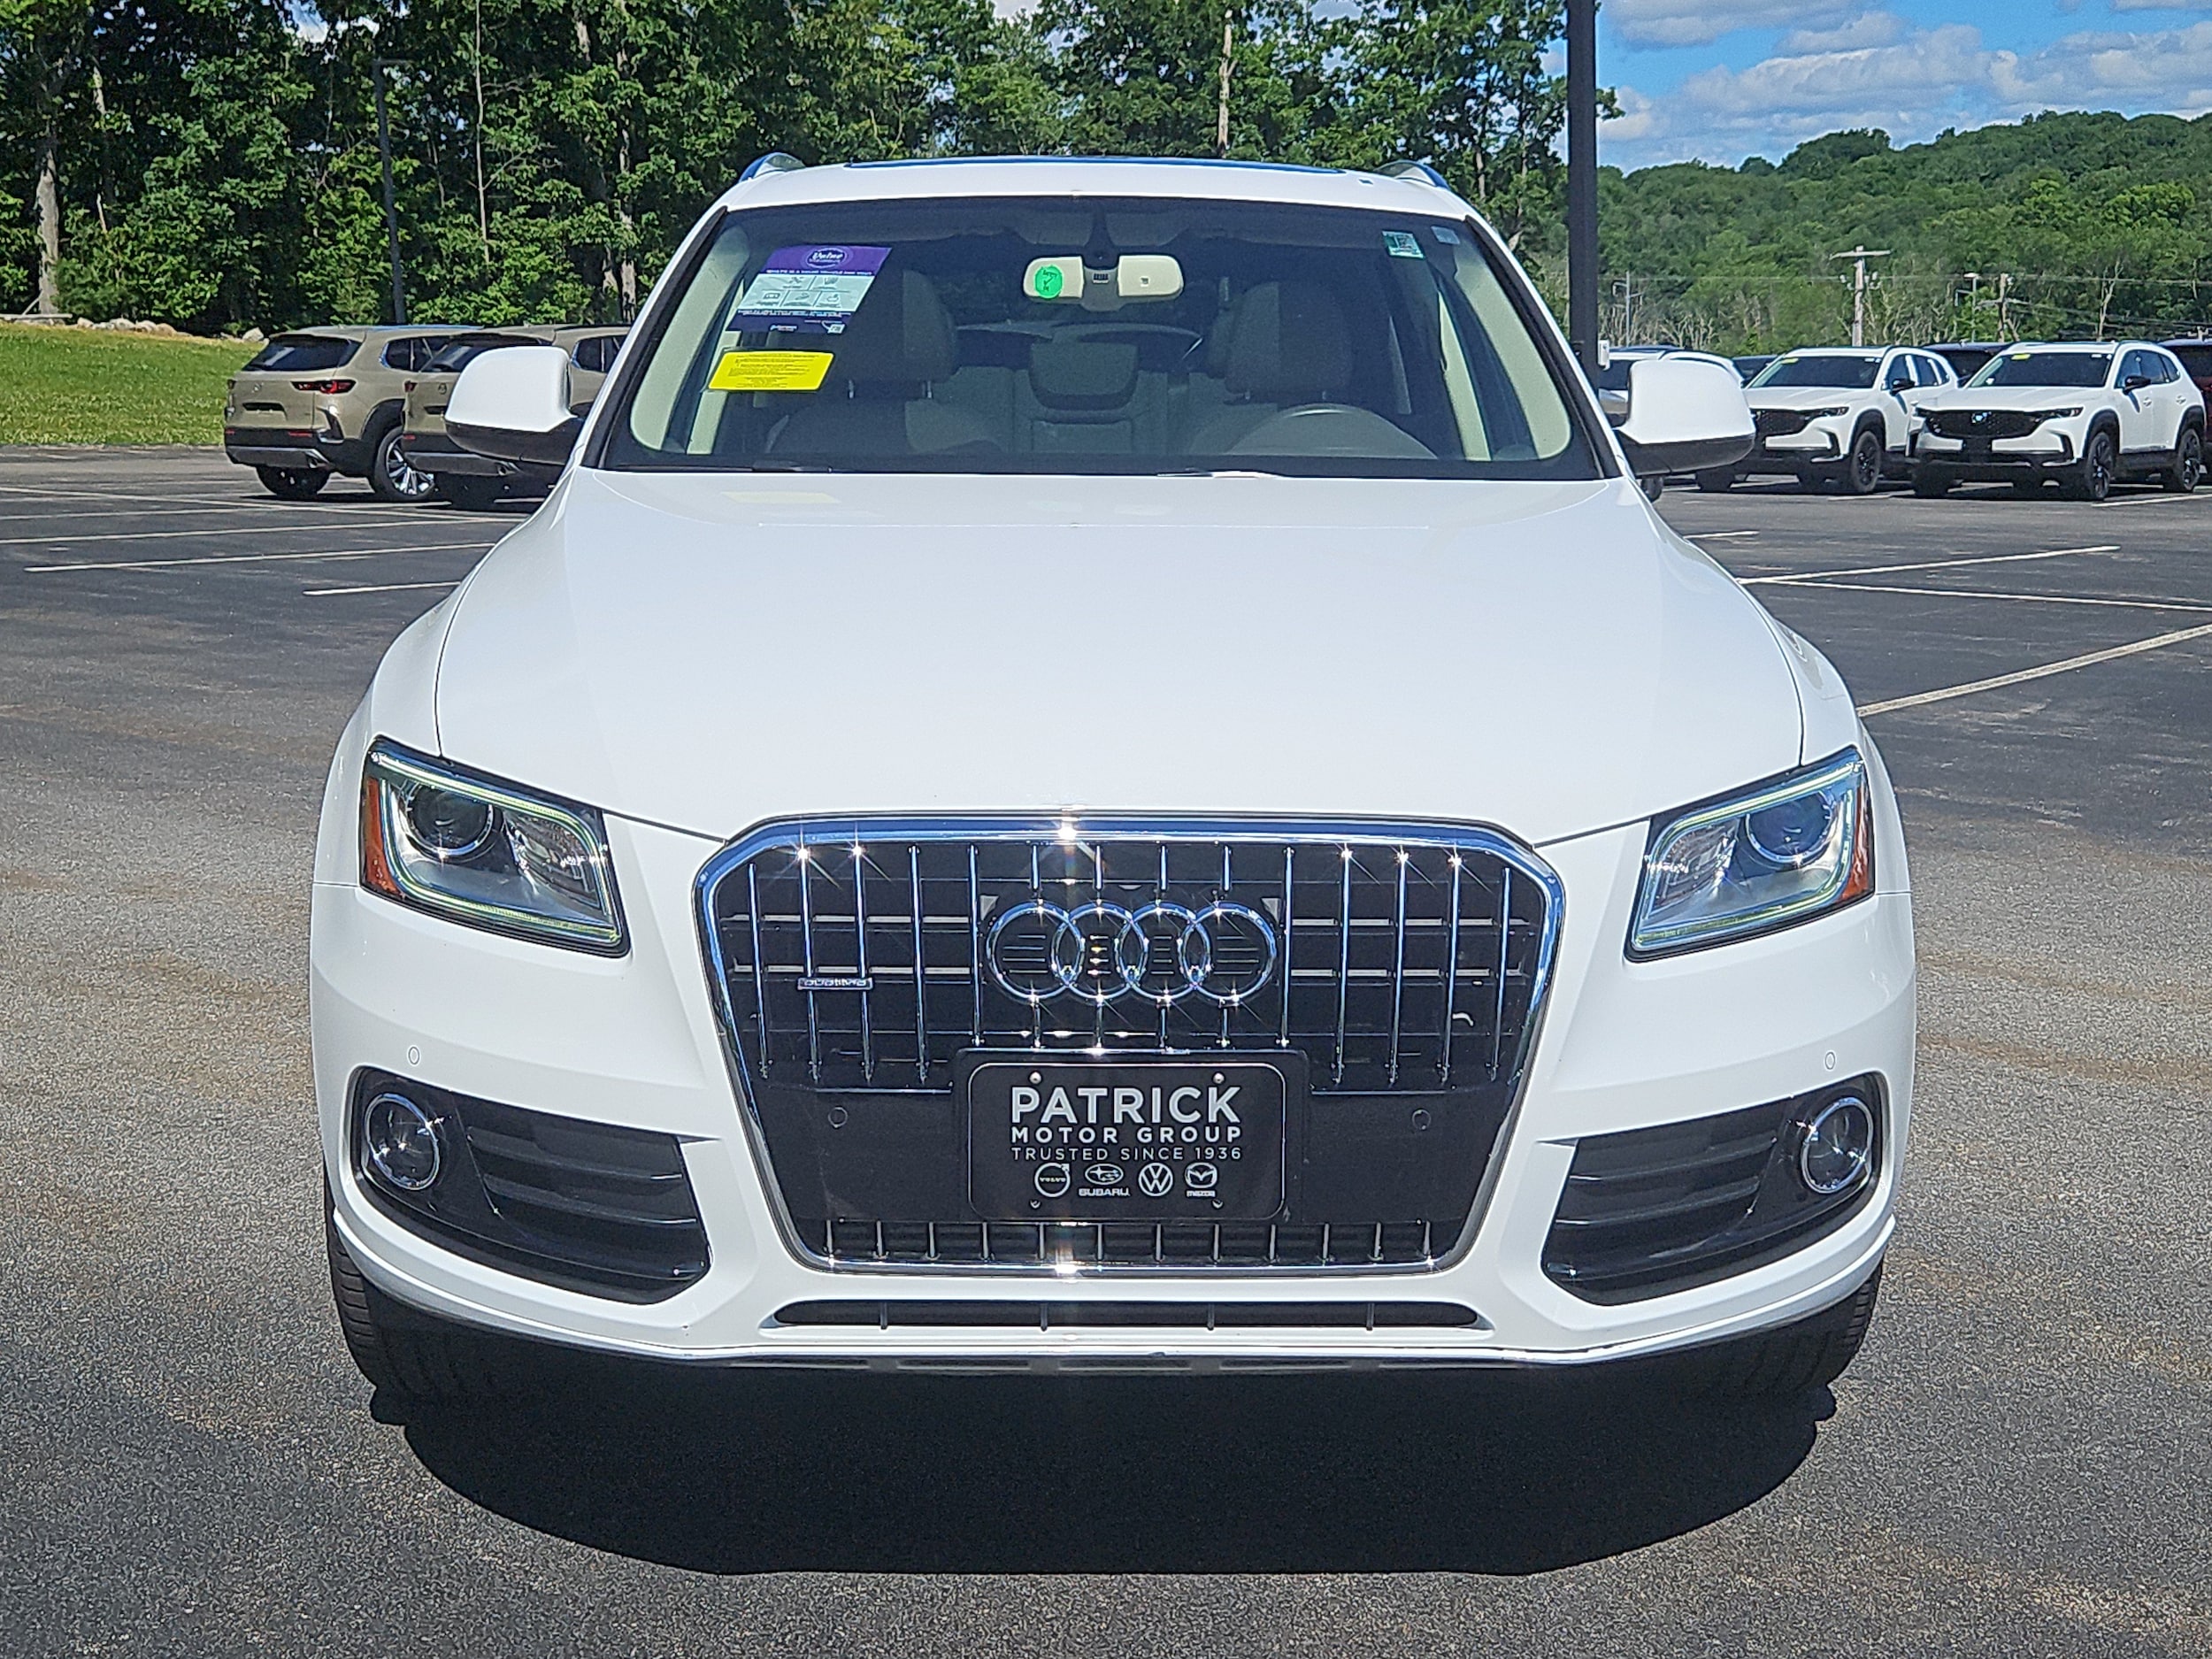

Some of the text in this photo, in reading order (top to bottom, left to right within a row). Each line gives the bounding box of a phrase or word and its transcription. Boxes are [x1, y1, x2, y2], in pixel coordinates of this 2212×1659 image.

[1011, 1087, 1240, 1124] PATRICK
[1011, 1125, 1240, 1144] MOTOR GROUP
[1011, 1147, 1240, 1161] TRUSTED SINCE 1936
[1078, 1187, 1130, 1196] SUBARU
